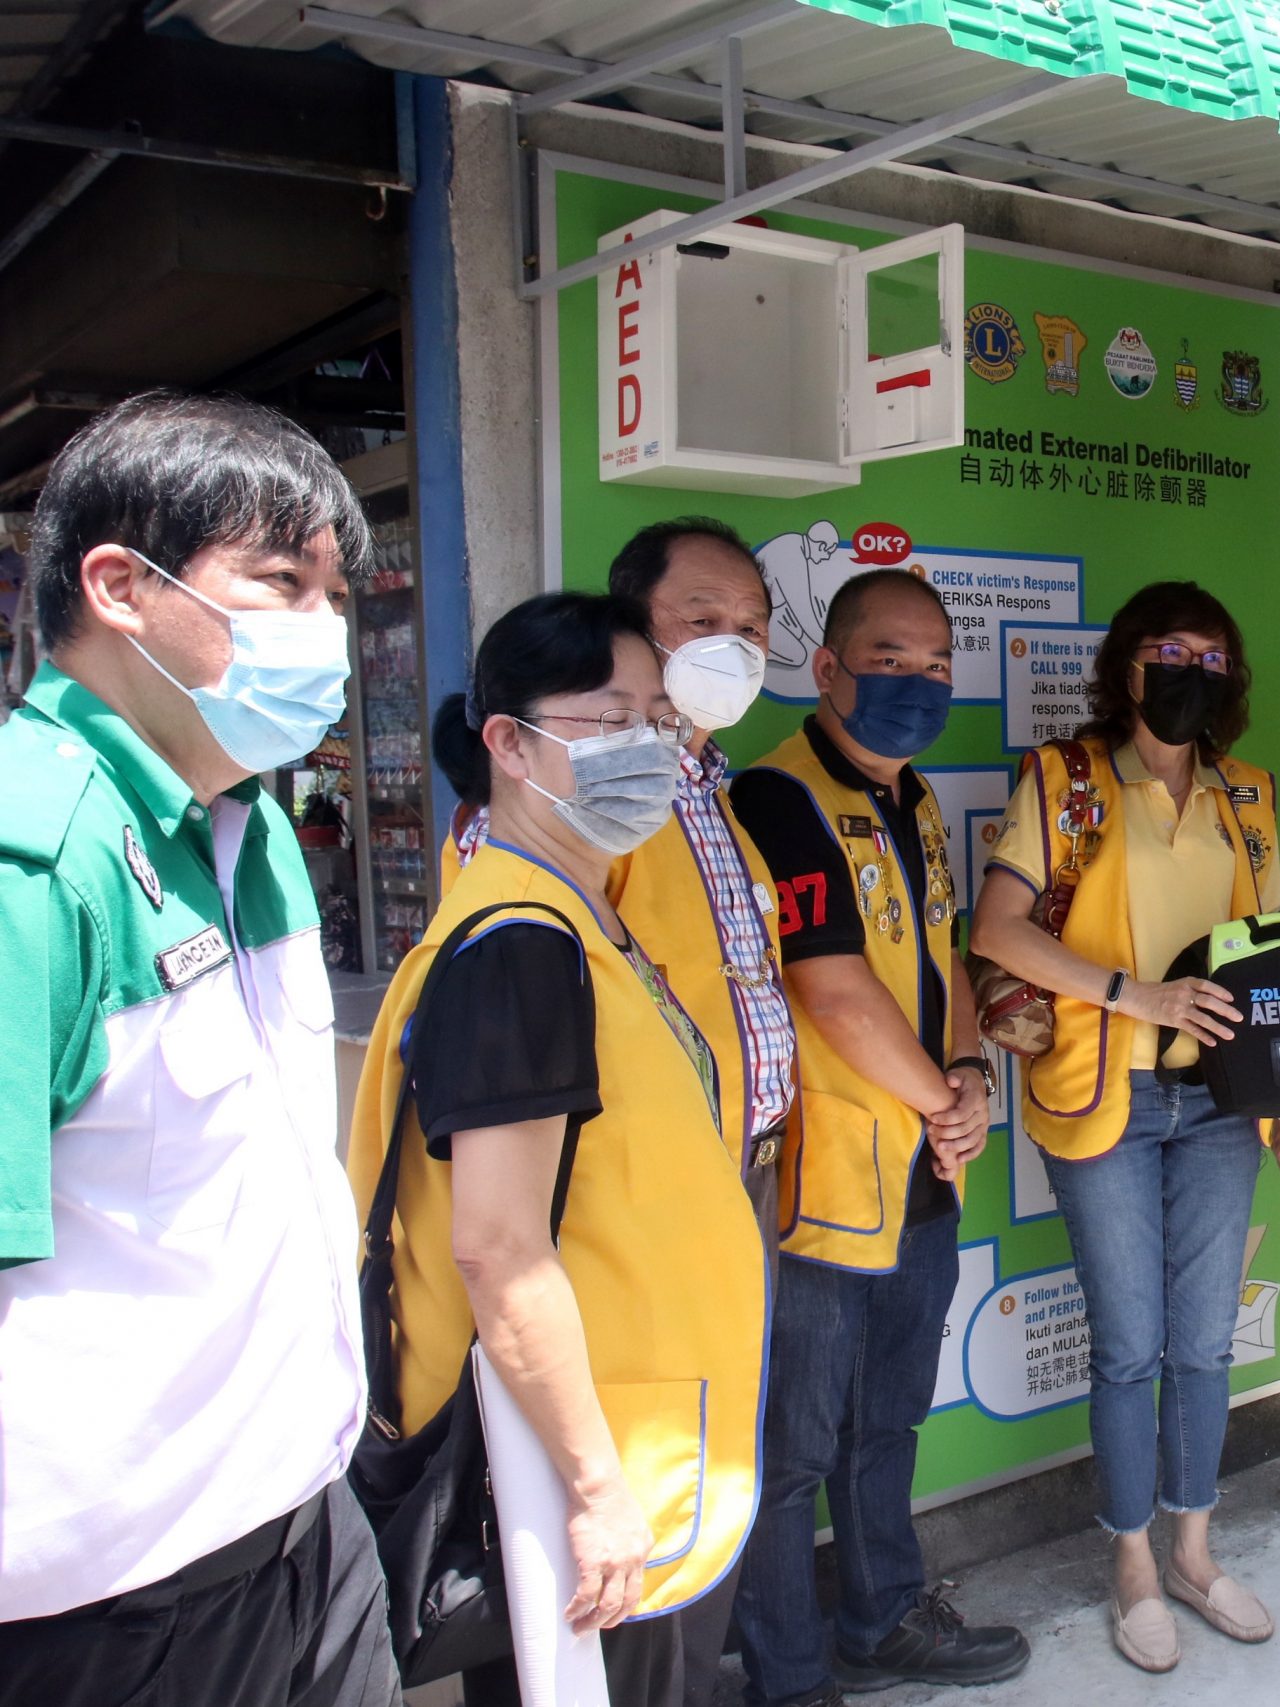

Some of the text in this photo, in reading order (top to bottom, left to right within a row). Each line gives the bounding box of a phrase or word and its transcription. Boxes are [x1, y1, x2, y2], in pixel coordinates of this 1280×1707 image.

[971, 306, 1013, 326] LIONS
[615, 233, 642, 437] AED
[984, 328, 1002, 356] L
[964, 427, 1252, 479] mated External Defibrillator
[960, 453, 1208, 507] 自动体外心脏除颤器
[858, 534, 906, 553] OK?
[932, 570, 973, 586] CHECK
[977, 573, 1020, 589] victim's
[1023, 576, 1076, 593] Response
[997, 593, 1051, 612] Respons
[947, 615, 986, 631] angsa
[1015, 642, 1022, 655] 2
[1030, 640, 1039, 654] If
[1042, 641, 1071, 656] there
[1074, 642, 1083, 656] is
[1031, 660, 1082, 676] CALL 999
[1031, 681, 1088, 695] Jika tiada
[1032, 703, 1084, 718] respons,
[1004, 1281, 1080, 1312] 8 Follow the
[1025, 1297, 1084, 1324] and PERFO
[1026, 1316, 1088, 1341] Ikuti araha
[1026, 1347, 1049, 1361] dan
